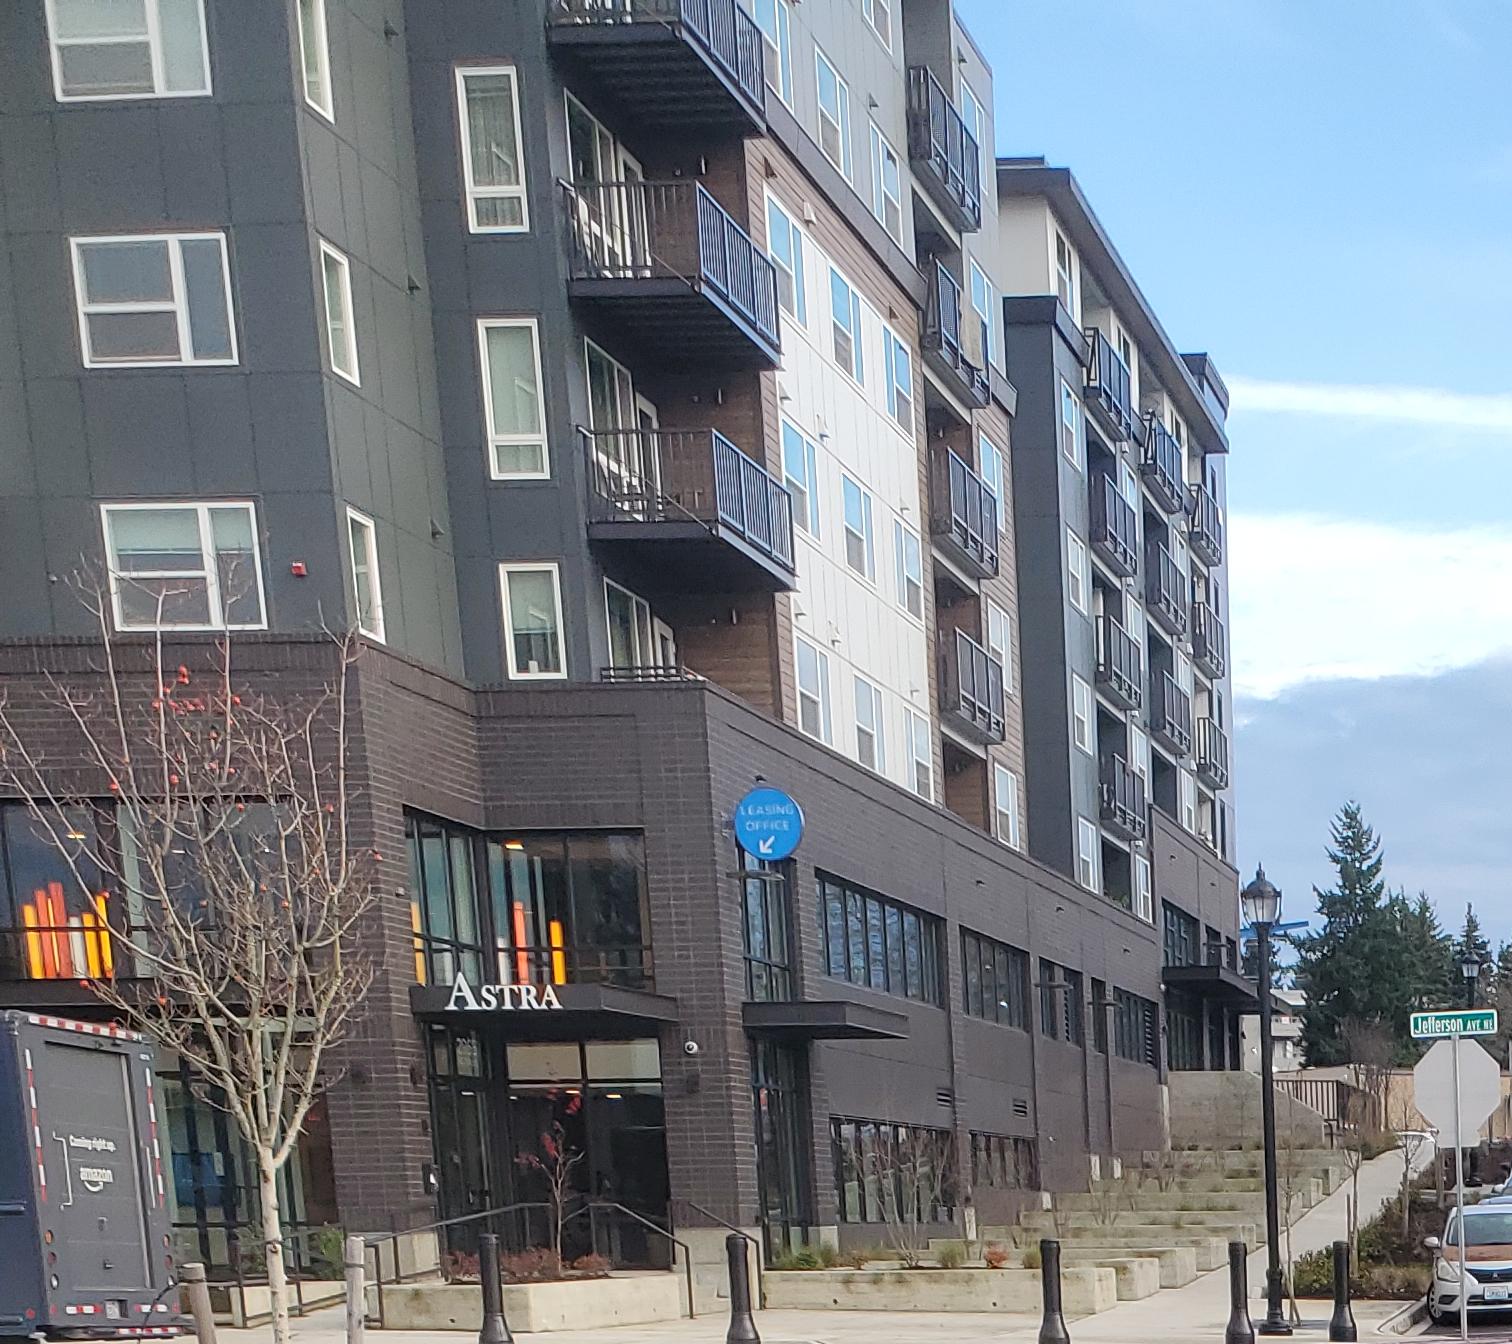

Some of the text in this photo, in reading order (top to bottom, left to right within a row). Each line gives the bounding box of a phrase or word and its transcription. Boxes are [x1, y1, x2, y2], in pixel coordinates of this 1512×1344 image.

[740, 804, 795, 816] LEASING
[745, 820, 790, 831] OFFICE
[443, 971, 565, 1011] ASTRA
[1414, 1016, 1464, 1034] Jefferson
[1466, 1019, 1481, 1031] AVE
[79, 1167, 114, 1183] amazon
